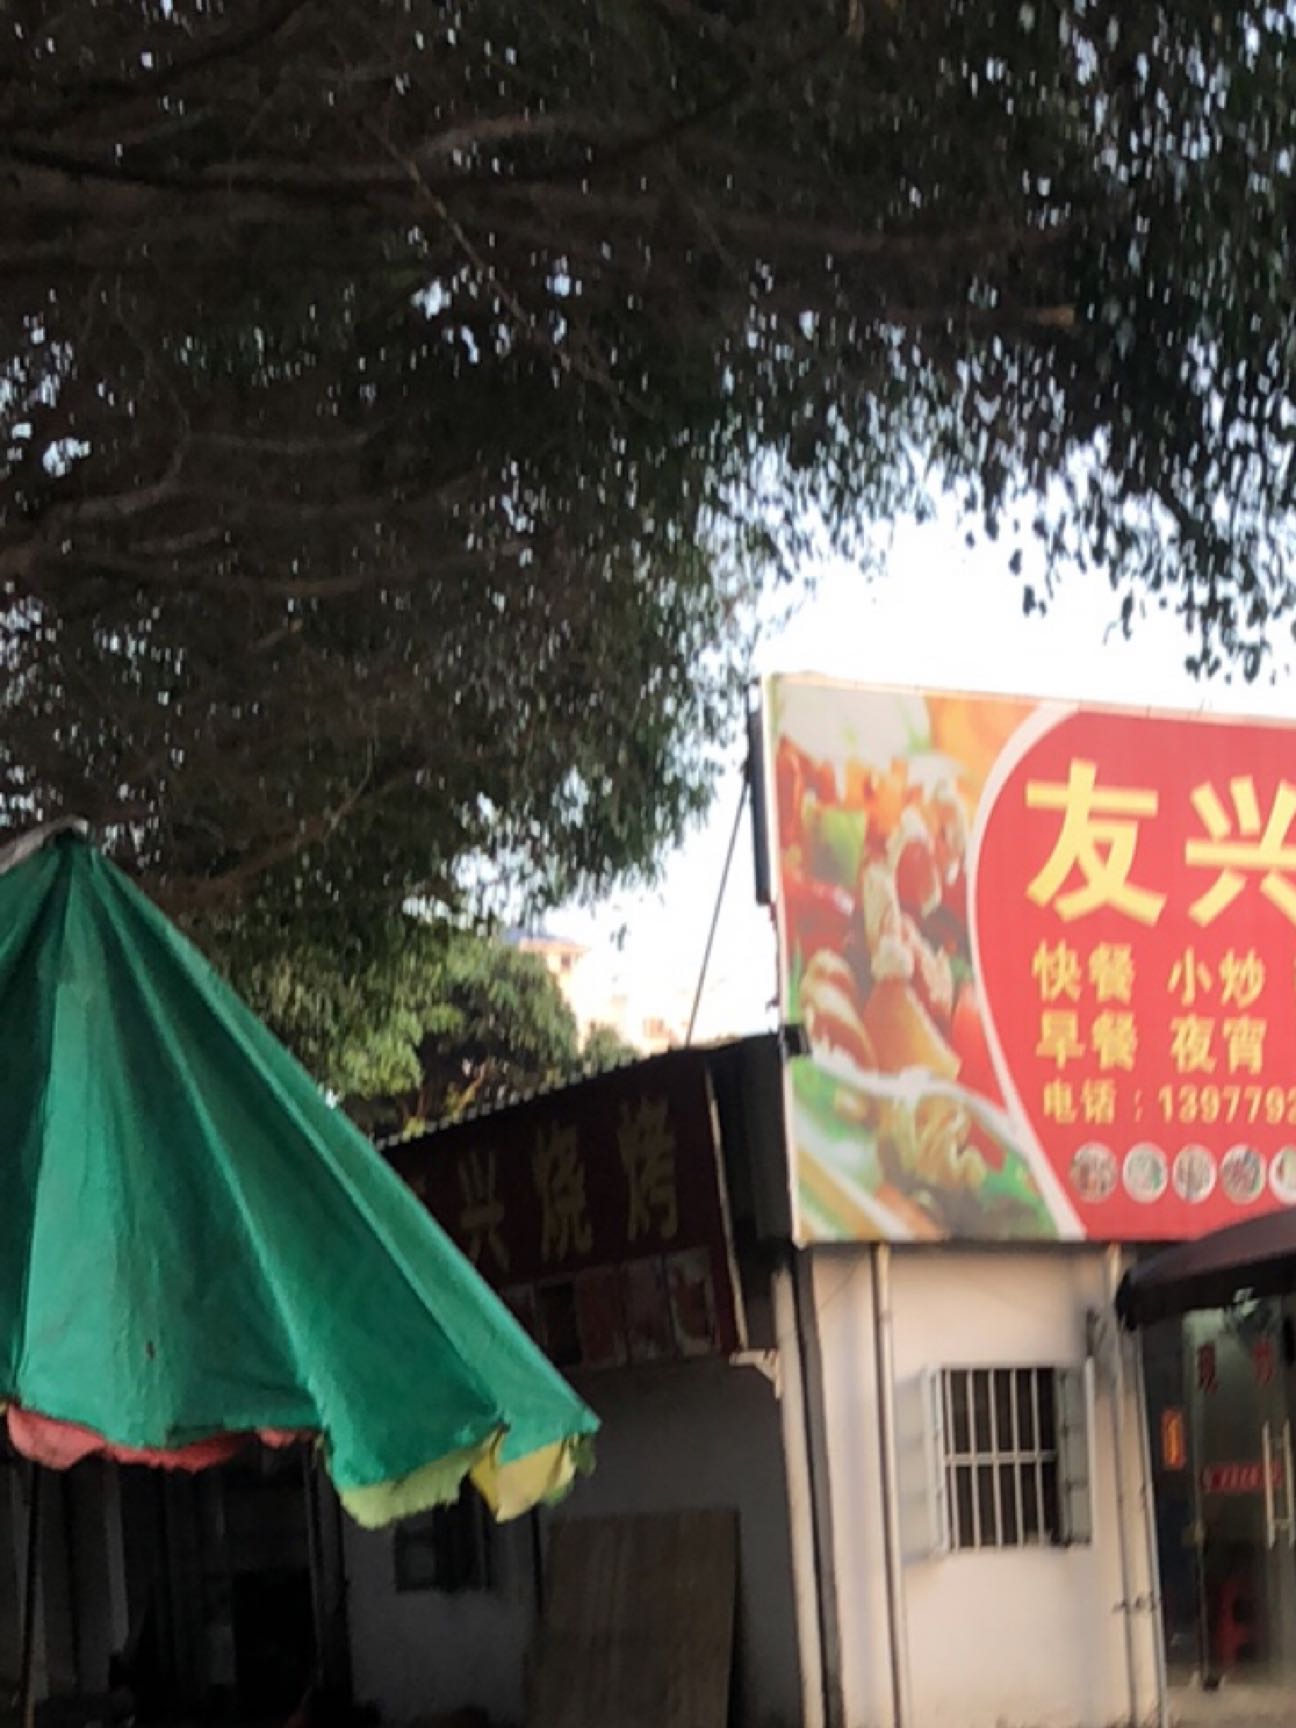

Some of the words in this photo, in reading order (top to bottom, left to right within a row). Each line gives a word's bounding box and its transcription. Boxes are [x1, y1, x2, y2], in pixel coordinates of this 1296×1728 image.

[1031, 939, 1136, 1006] 快餐
[1168, 945, 1266, 1009] 小炒
[1035, 1008, 1139, 1073] 早餐
[1170, 1013, 1268, 1076] 夜宵
